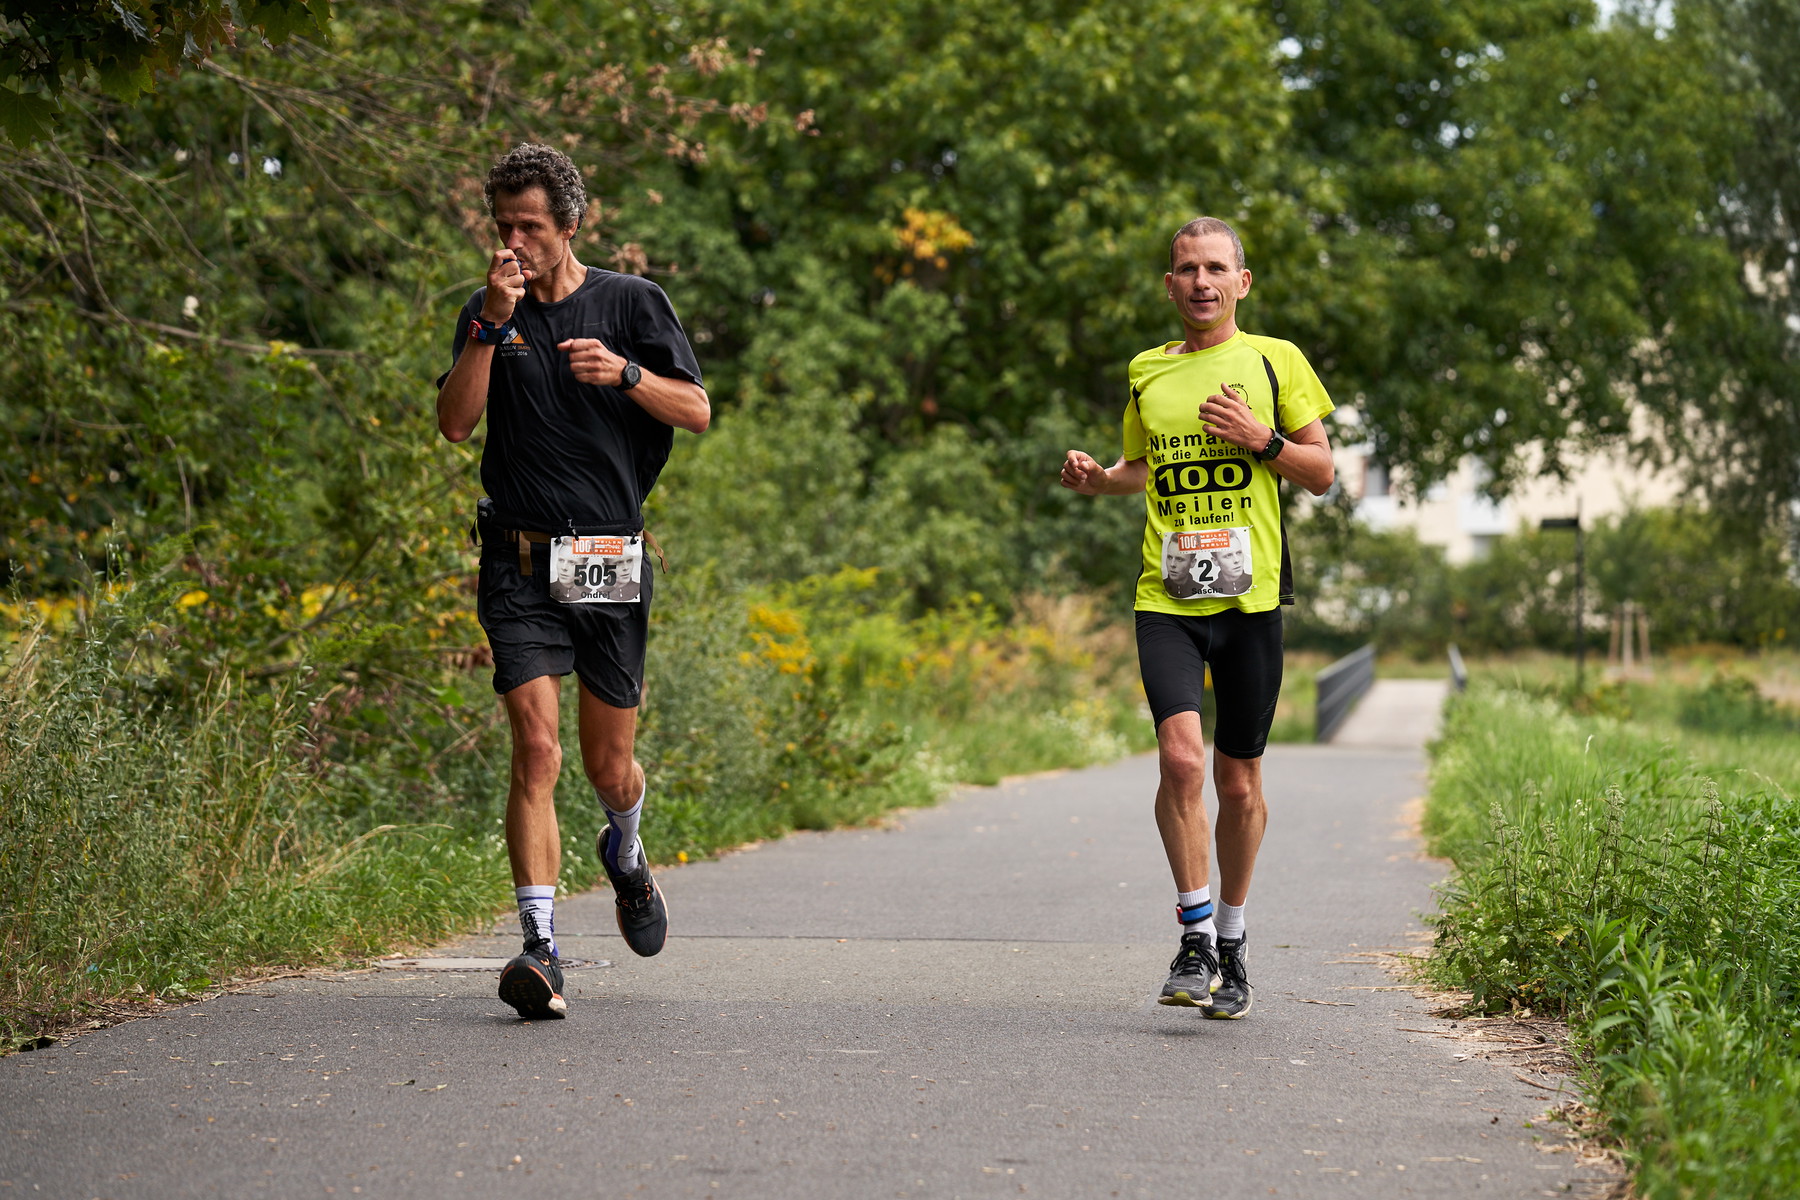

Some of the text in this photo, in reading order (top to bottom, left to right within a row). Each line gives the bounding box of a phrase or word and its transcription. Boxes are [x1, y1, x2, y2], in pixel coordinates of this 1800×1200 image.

[1152, 453, 1166, 465] hat
[1172, 450, 1191, 460] die
[1158, 463, 1244, 493] 100
[1157, 495, 1252, 517] Meilen
[1174, 512, 1234, 527] zu laufen!
[574, 540, 591, 552] 100
[1180, 535, 1197, 549] 100
[574, 565, 616, 586] 505
[1197, 559, 1214, 582] 2
[1191, 586, 1223, 595] Sascha
